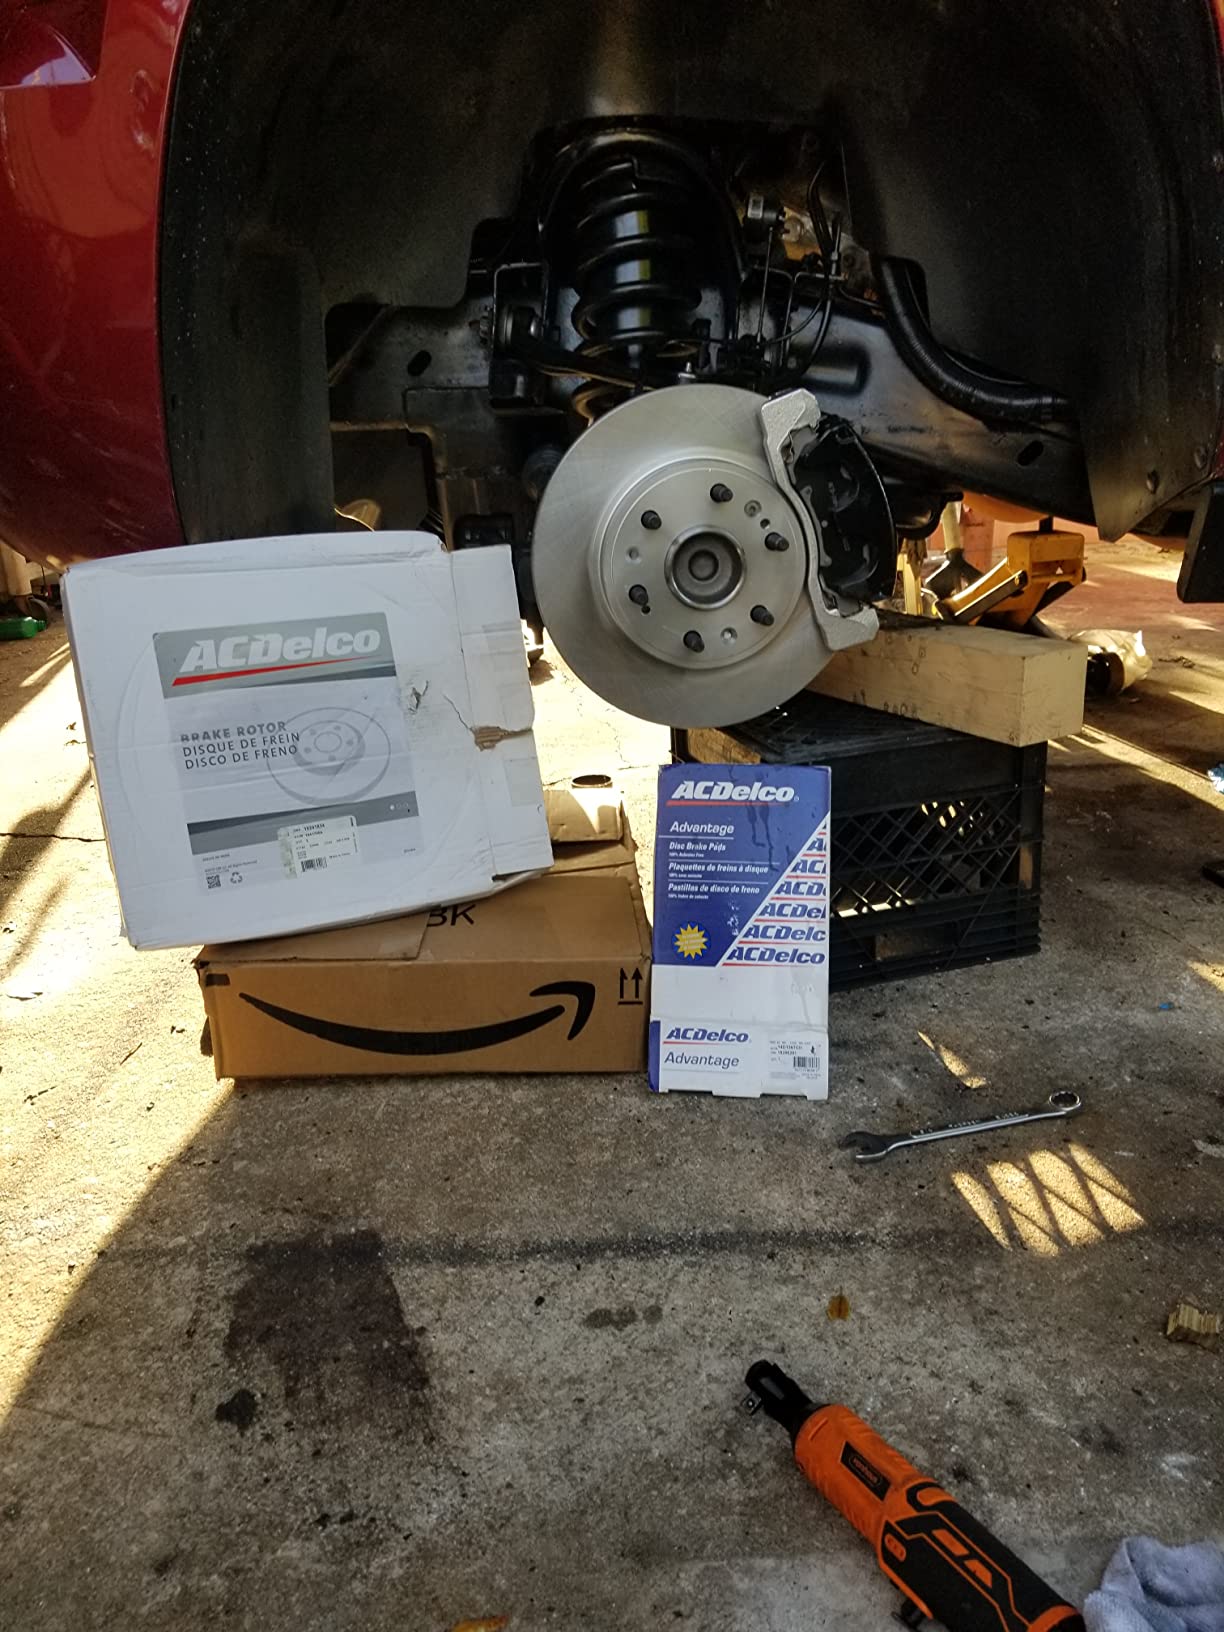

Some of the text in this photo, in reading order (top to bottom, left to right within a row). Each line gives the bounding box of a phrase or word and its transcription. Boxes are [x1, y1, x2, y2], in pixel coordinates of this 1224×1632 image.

[179, 626, 382, 673] ACDelco
[180, 721, 287, 743] BRAKE ROTOR
[183, 732, 300, 758] DISQUE DE FREIN
[185, 745, 297, 770] DISCO DE FRENO
[671, 780, 795, 802] ACDelco
[669, 821, 735, 837] Advantage
[669, 842, 727, 852] Disc Brake Pads
[668, 862, 706, 873] Plaquettes
[707, 864, 716, 872] de
[717, 863, 738, 873] freins
[744, 864, 769, 875] disque
[668, 882, 760, 894] Pastillas de disco de freno
[726, 946, 826, 964] ACDelco
[666, 1027, 749, 1043] ACDelco
[664, 1051, 740, 1070] Advantage
